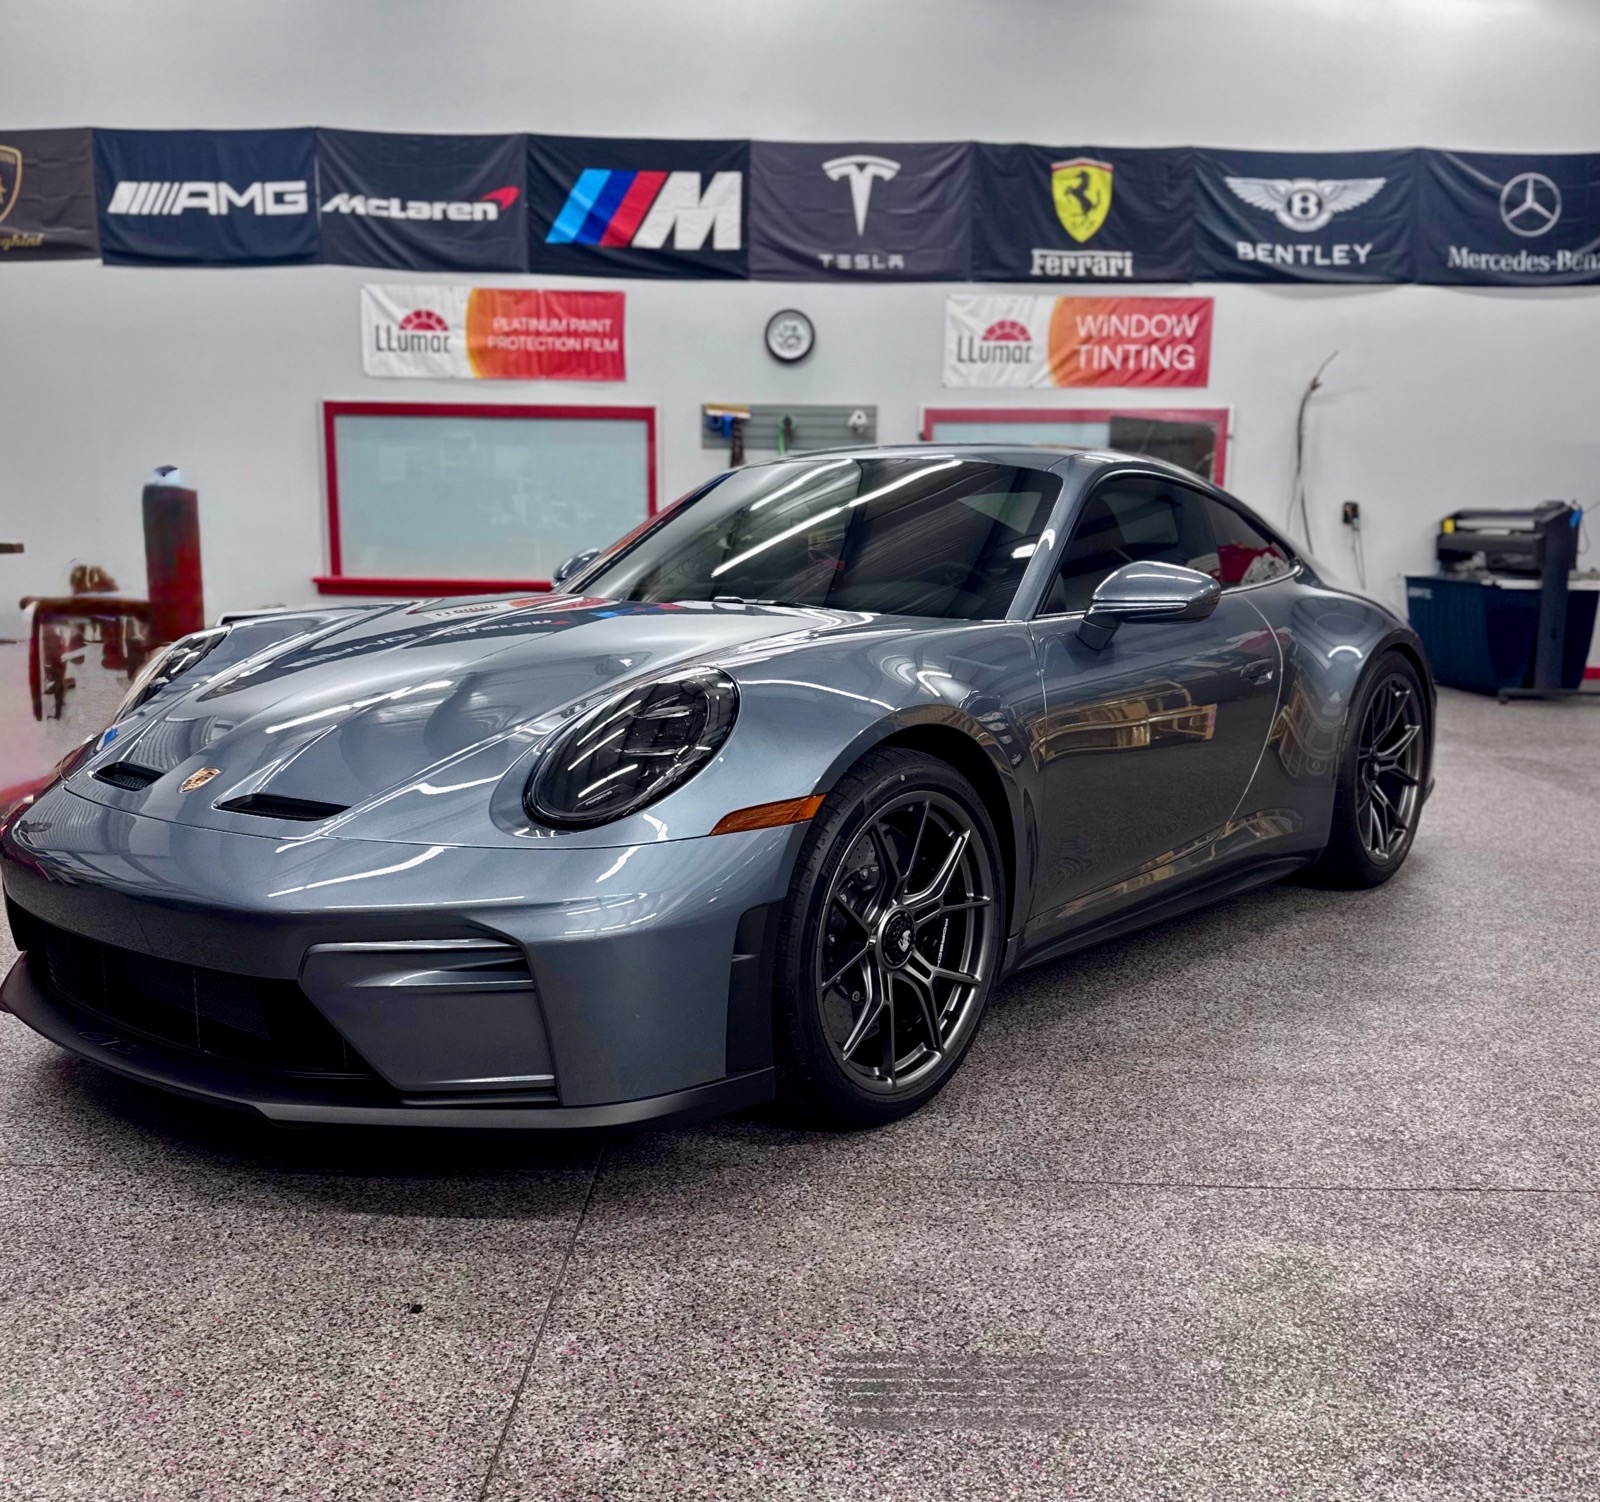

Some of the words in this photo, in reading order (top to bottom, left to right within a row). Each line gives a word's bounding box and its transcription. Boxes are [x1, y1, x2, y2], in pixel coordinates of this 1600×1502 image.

[171, 181, 308, 215] AMG
[320, 192, 498, 221] McLaren
[818, 253, 904, 270] TESLA
[1030, 248, 1133, 277] Ferrari
[1236, 240, 1373, 266] BENTLEY
[1447, 245, 1600, 273] Mercedes-Ben
[375, 324, 450, 354] LLumar
[493, 317, 567, 333] PLATINUM
[570, 318, 612, 333] PAINT
[1075, 313, 1200, 339] WINDOW
[487, 335, 580, 352] PROTECTION
[583, 336, 619, 353] FILM
[957, 335, 1033, 364] LLumar
[1078, 343, 1196, 371] TINTING
